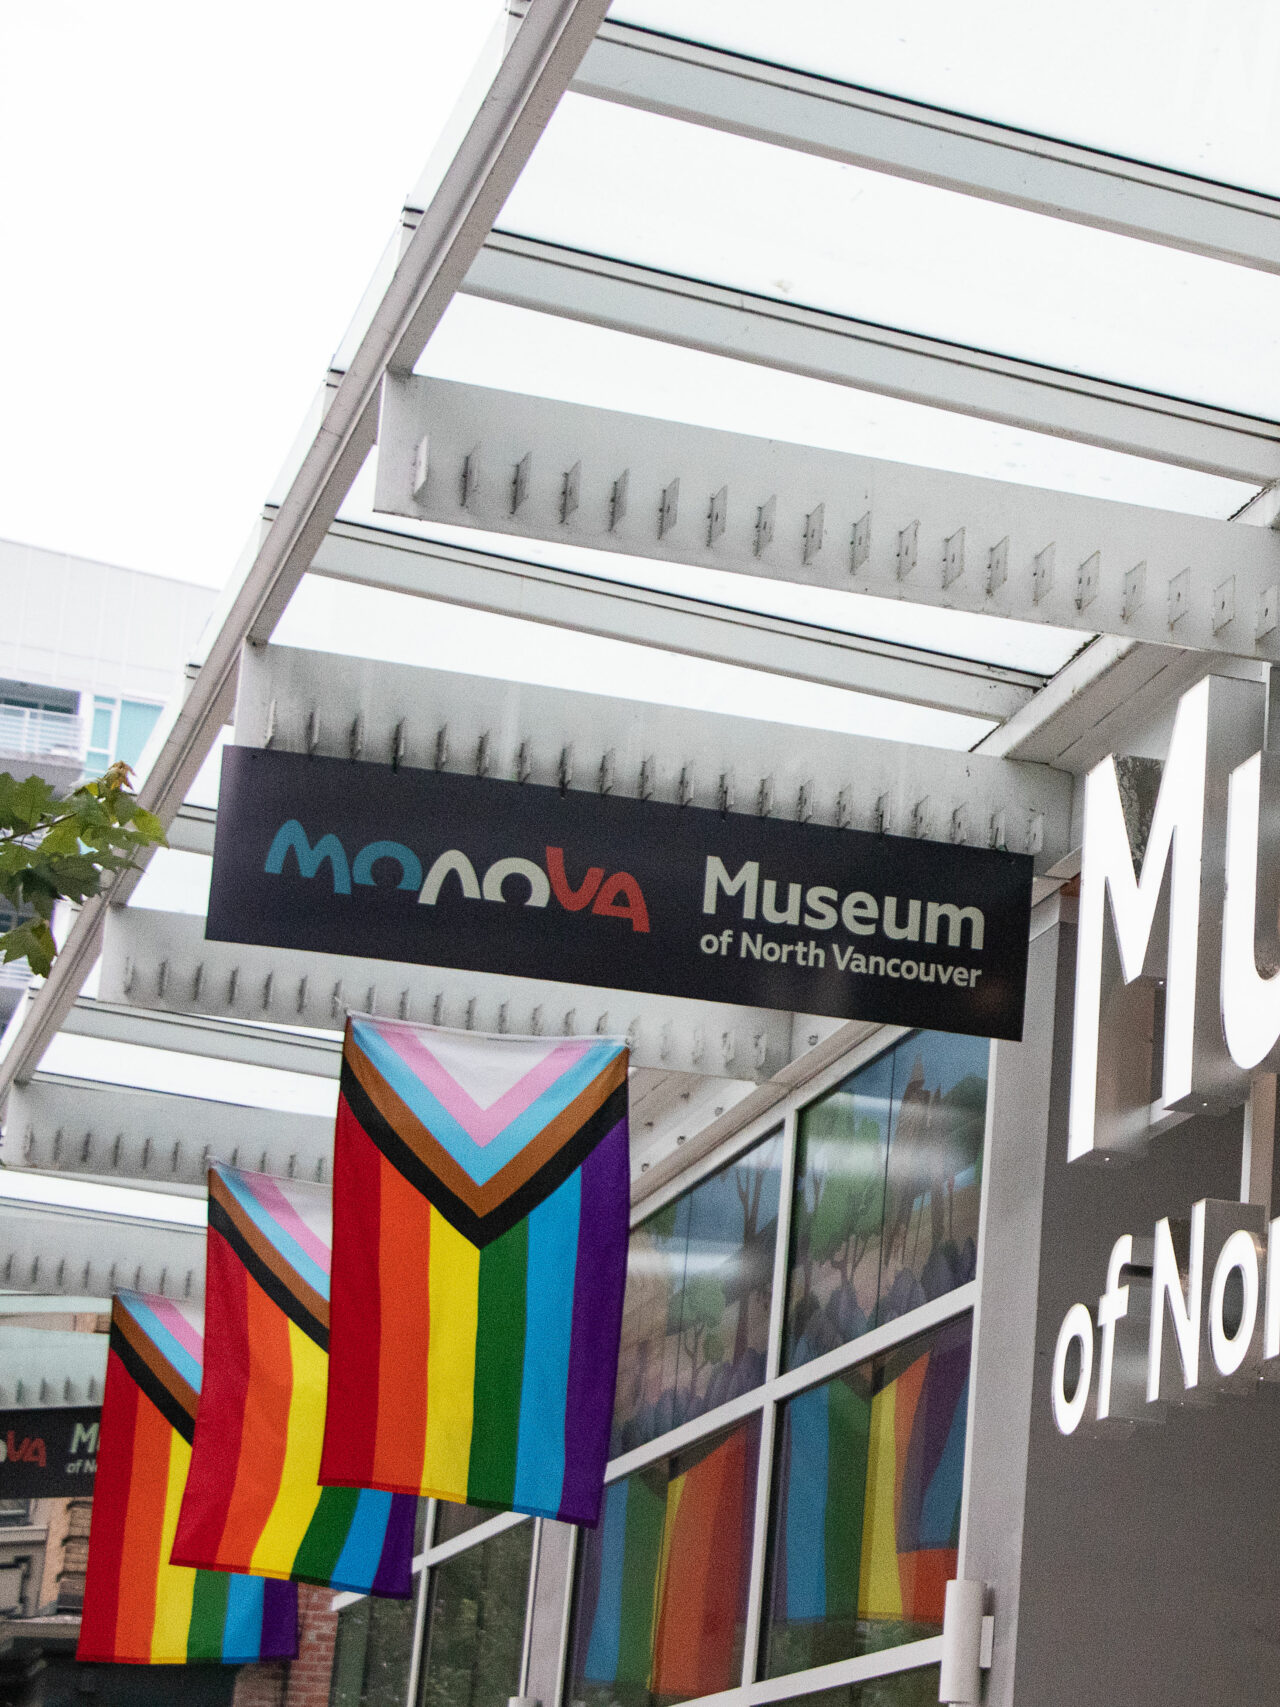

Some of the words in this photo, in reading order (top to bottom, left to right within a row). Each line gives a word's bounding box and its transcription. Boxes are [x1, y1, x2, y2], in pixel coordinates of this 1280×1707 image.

[701, 855, 985, 951] Museum
[699, 931, 734, 955] of
[740, 936, 826, 969] North
[832, 943, 984, 988] Vancouver
[1051, 1234, 1132, 1436] of
